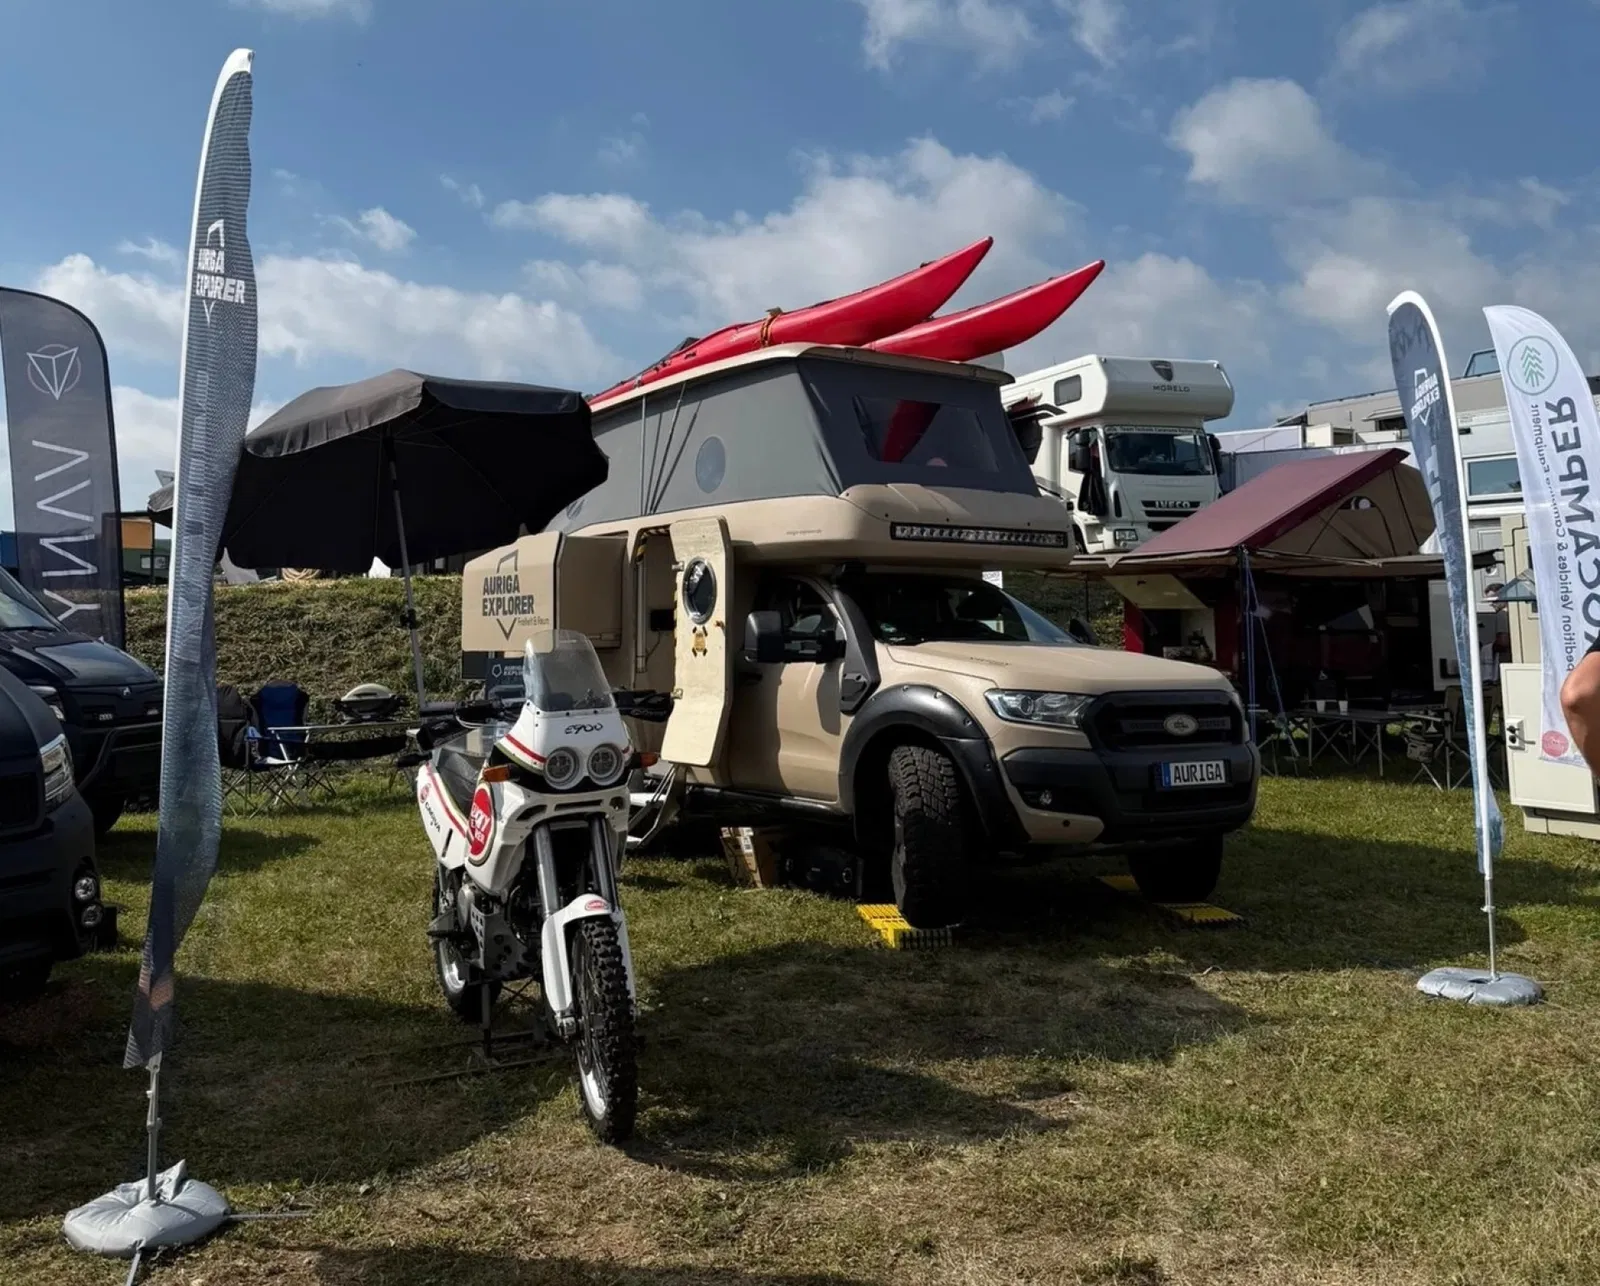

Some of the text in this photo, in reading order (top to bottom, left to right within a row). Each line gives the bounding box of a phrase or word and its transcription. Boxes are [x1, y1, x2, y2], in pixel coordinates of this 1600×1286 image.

[1152, 384, 1191, 392] MORELO
[1155, 501, 1191, 509] IVECO
[483, 574, 520, 596] AURIGA
[482, 595, 535, 617] EXPLORER
[1174, 763, 1223, 783] AURIGA
